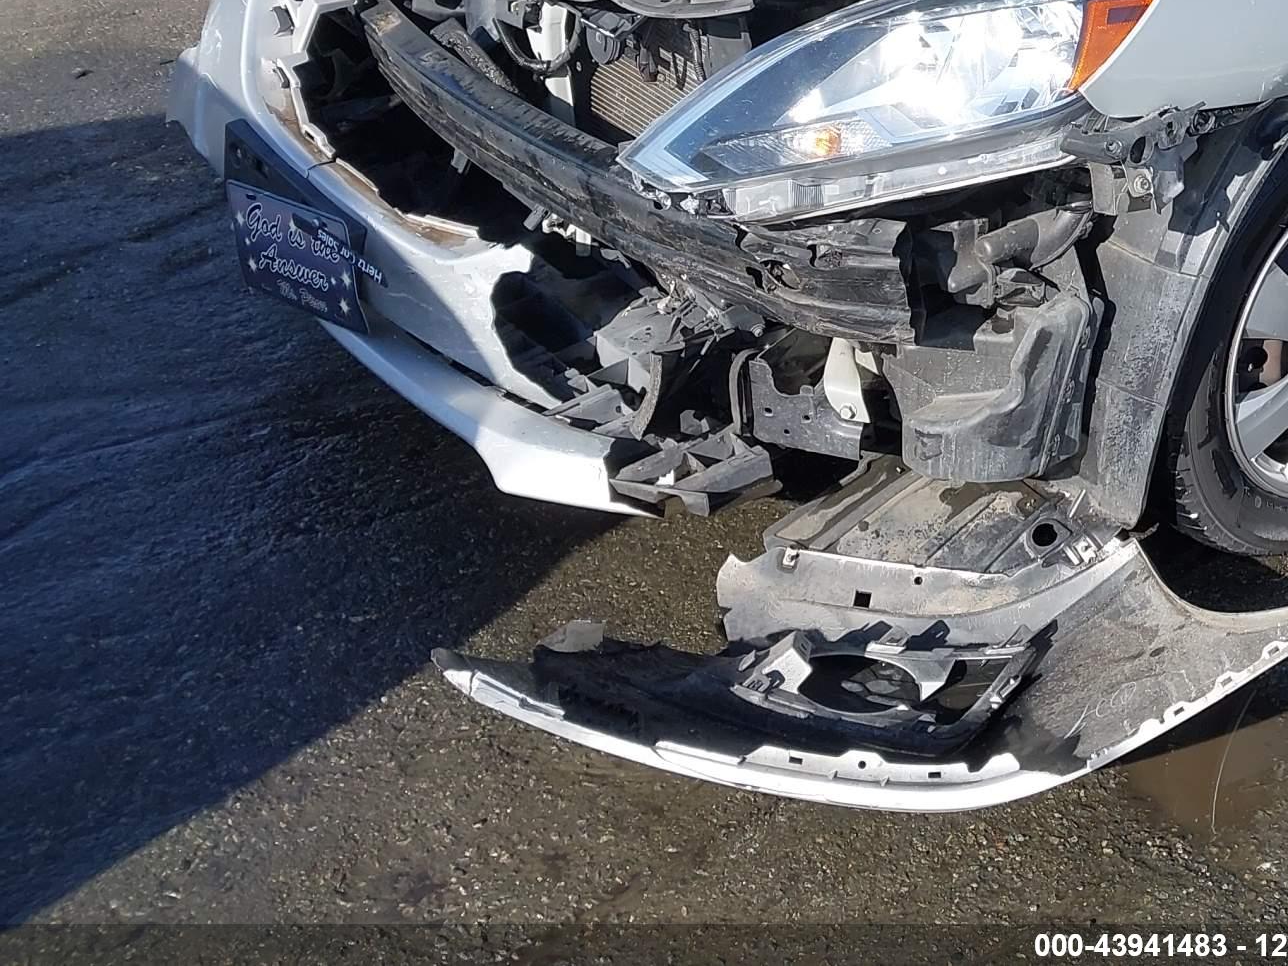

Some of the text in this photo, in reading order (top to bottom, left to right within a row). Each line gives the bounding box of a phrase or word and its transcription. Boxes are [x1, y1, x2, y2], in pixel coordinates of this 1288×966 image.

[246, 202, 283, 242] God
[288, 226, 306, 250] is
[318, 228, 341, 255] Sales
[259, 242, 329, 292] Answer
